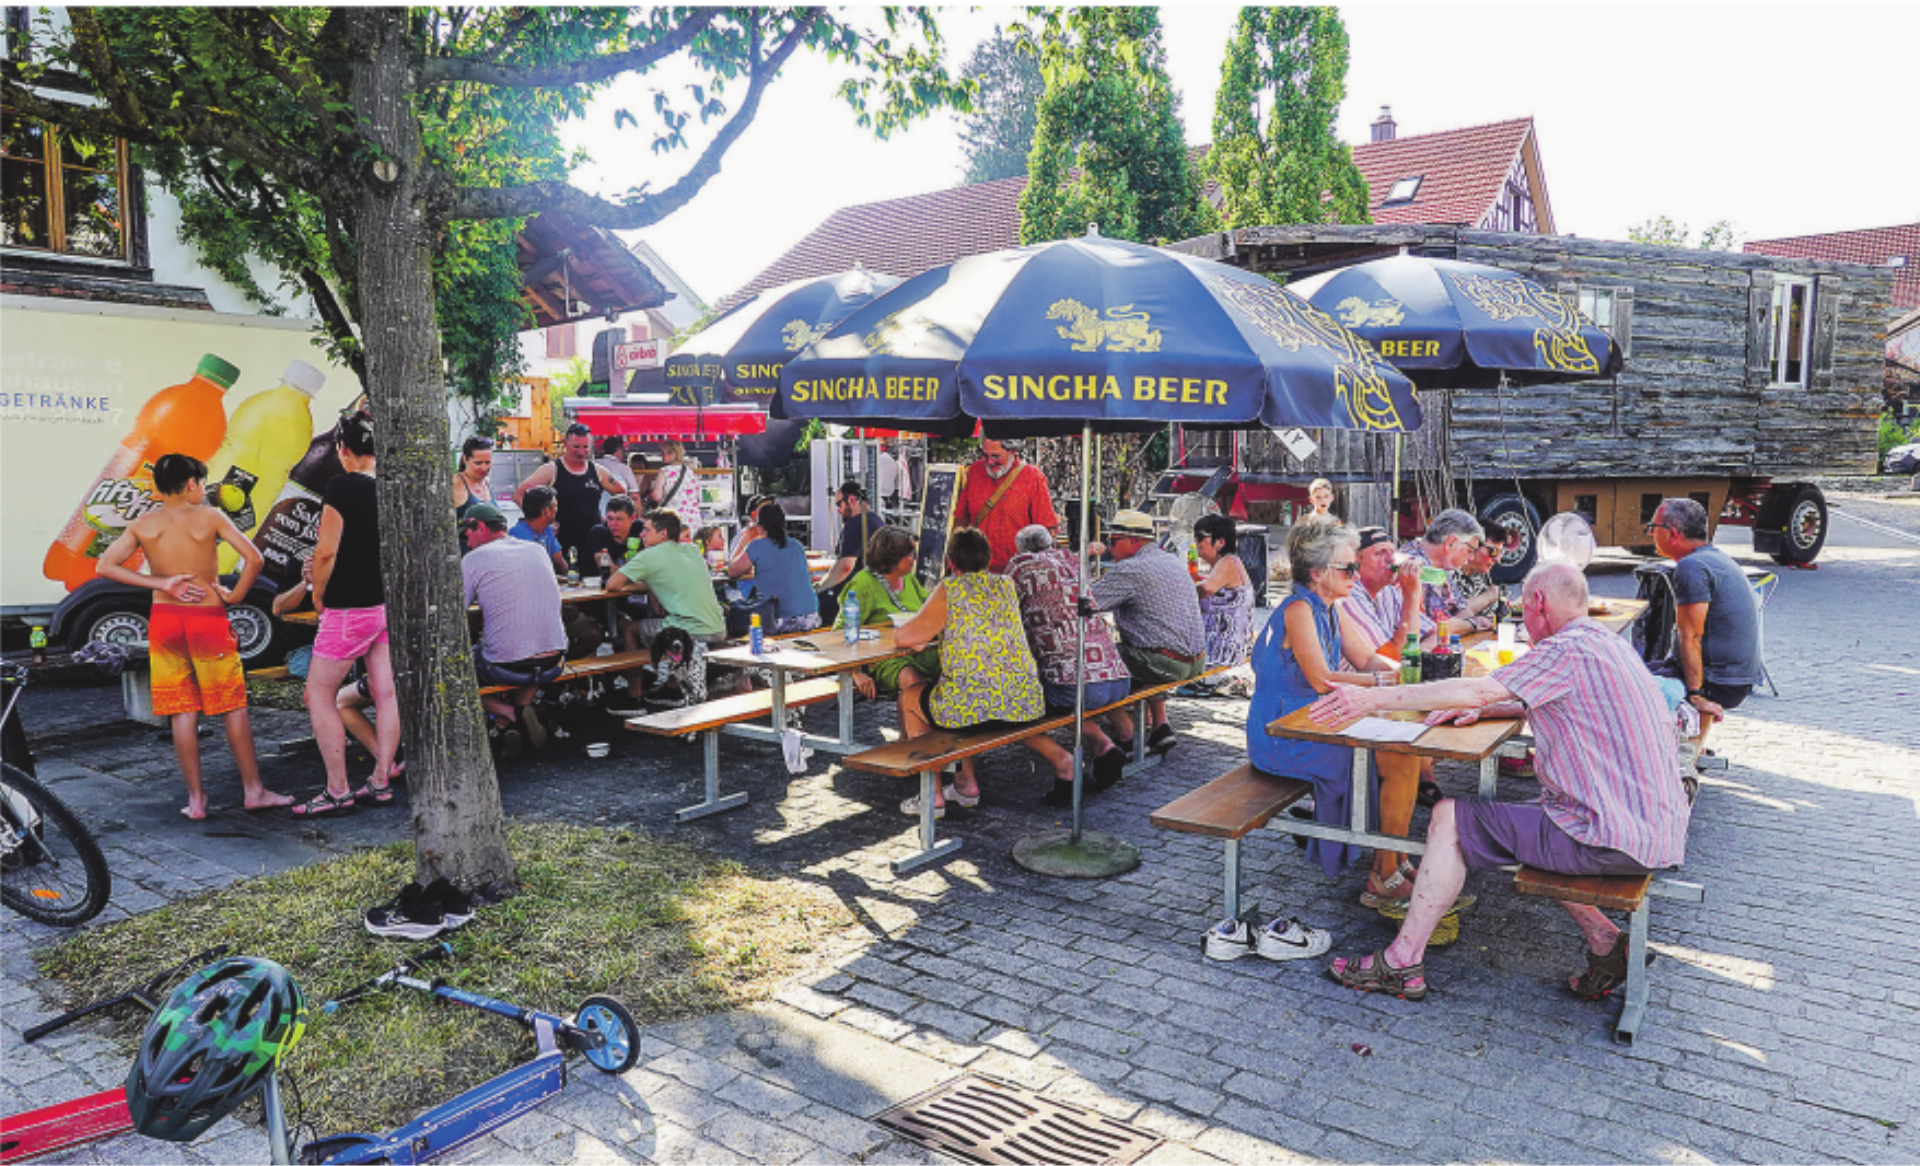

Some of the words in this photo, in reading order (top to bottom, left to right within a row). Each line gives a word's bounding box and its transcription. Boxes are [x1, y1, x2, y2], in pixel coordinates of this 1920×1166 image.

[629, 345, 656, 361] airbnb
[1381, 340, 1440, 357] BEER
[791, 377, 879, 402] SINGHA
[885, 376, 939, 401] BEER
[983, 375, 1122, 400] SINGHA
[1133, 376, 1228, 405] BEER
